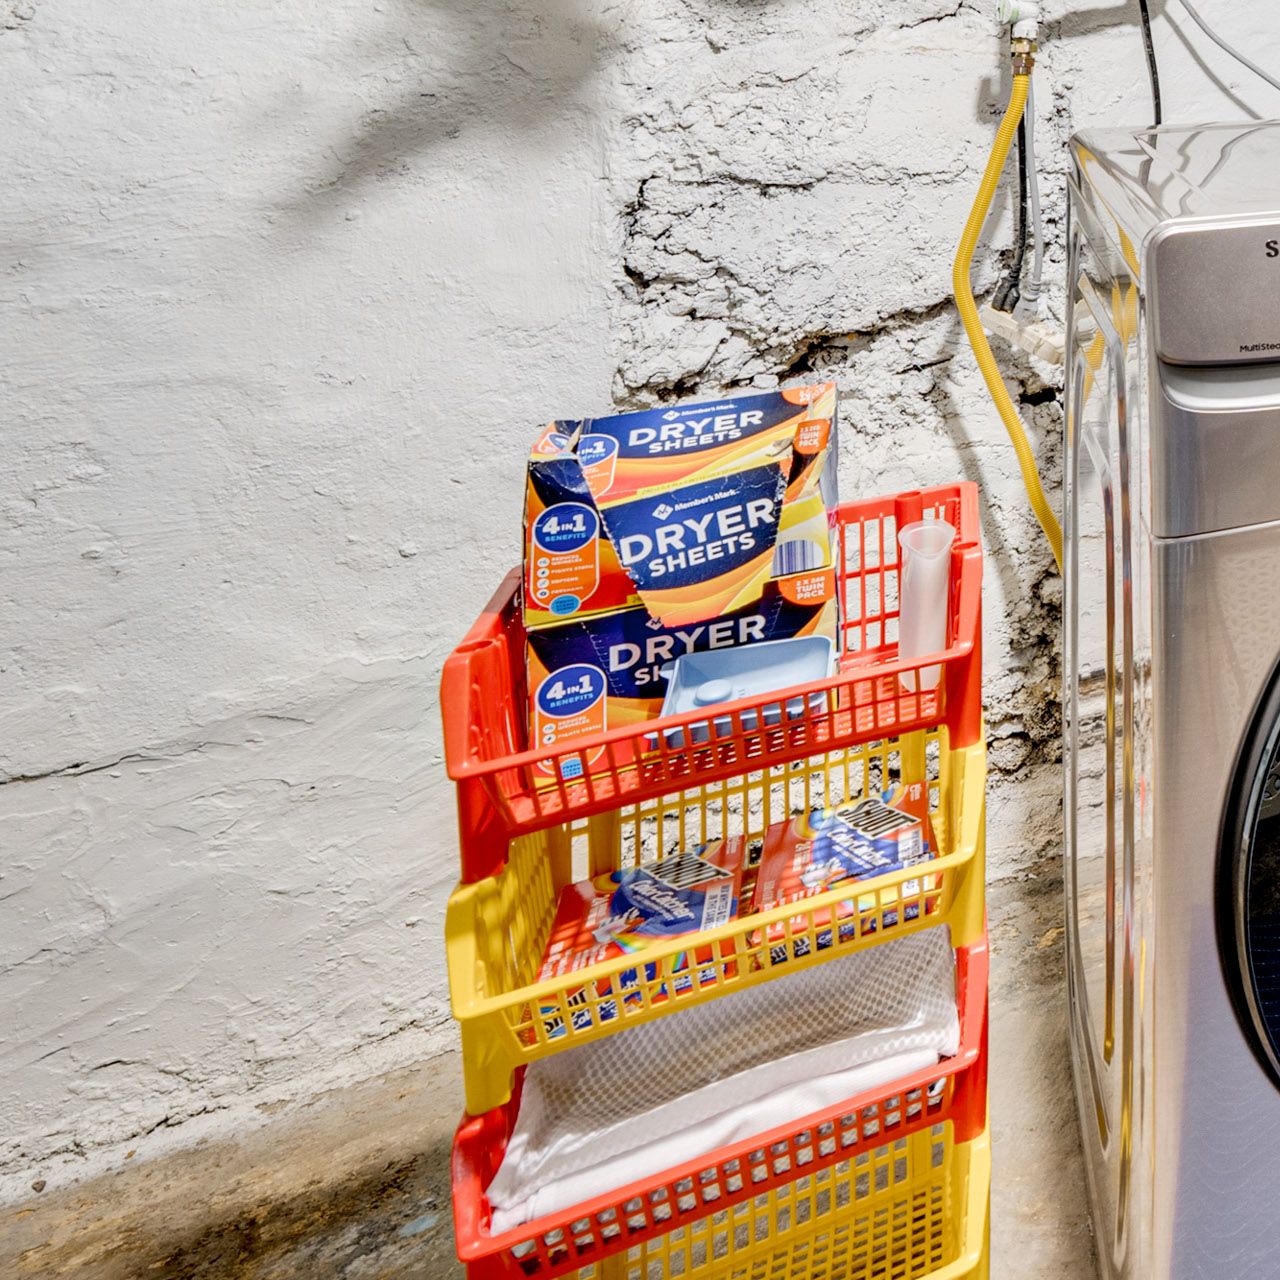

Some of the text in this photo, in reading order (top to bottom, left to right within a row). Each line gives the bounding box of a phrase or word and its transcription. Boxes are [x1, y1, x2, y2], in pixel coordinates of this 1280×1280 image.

[628, 410, 765, 447] DRYER
[648, 428, 742, 454] SHEETS
[674, 494, 714, 512] Member's
[544, 531, 587, 543] BENEFITS
[619, 496, 776, 566] DRYER
[648, 531, 756, 578] SHEETS
[796, 582, 825, 592] TWIN
[796, 589, 826, 600] PACK
[608, 614, 767, 673] DRYER
[549, 693, 594, 709] BENEFITS
[837, 799, 917, 838] SHOUT
